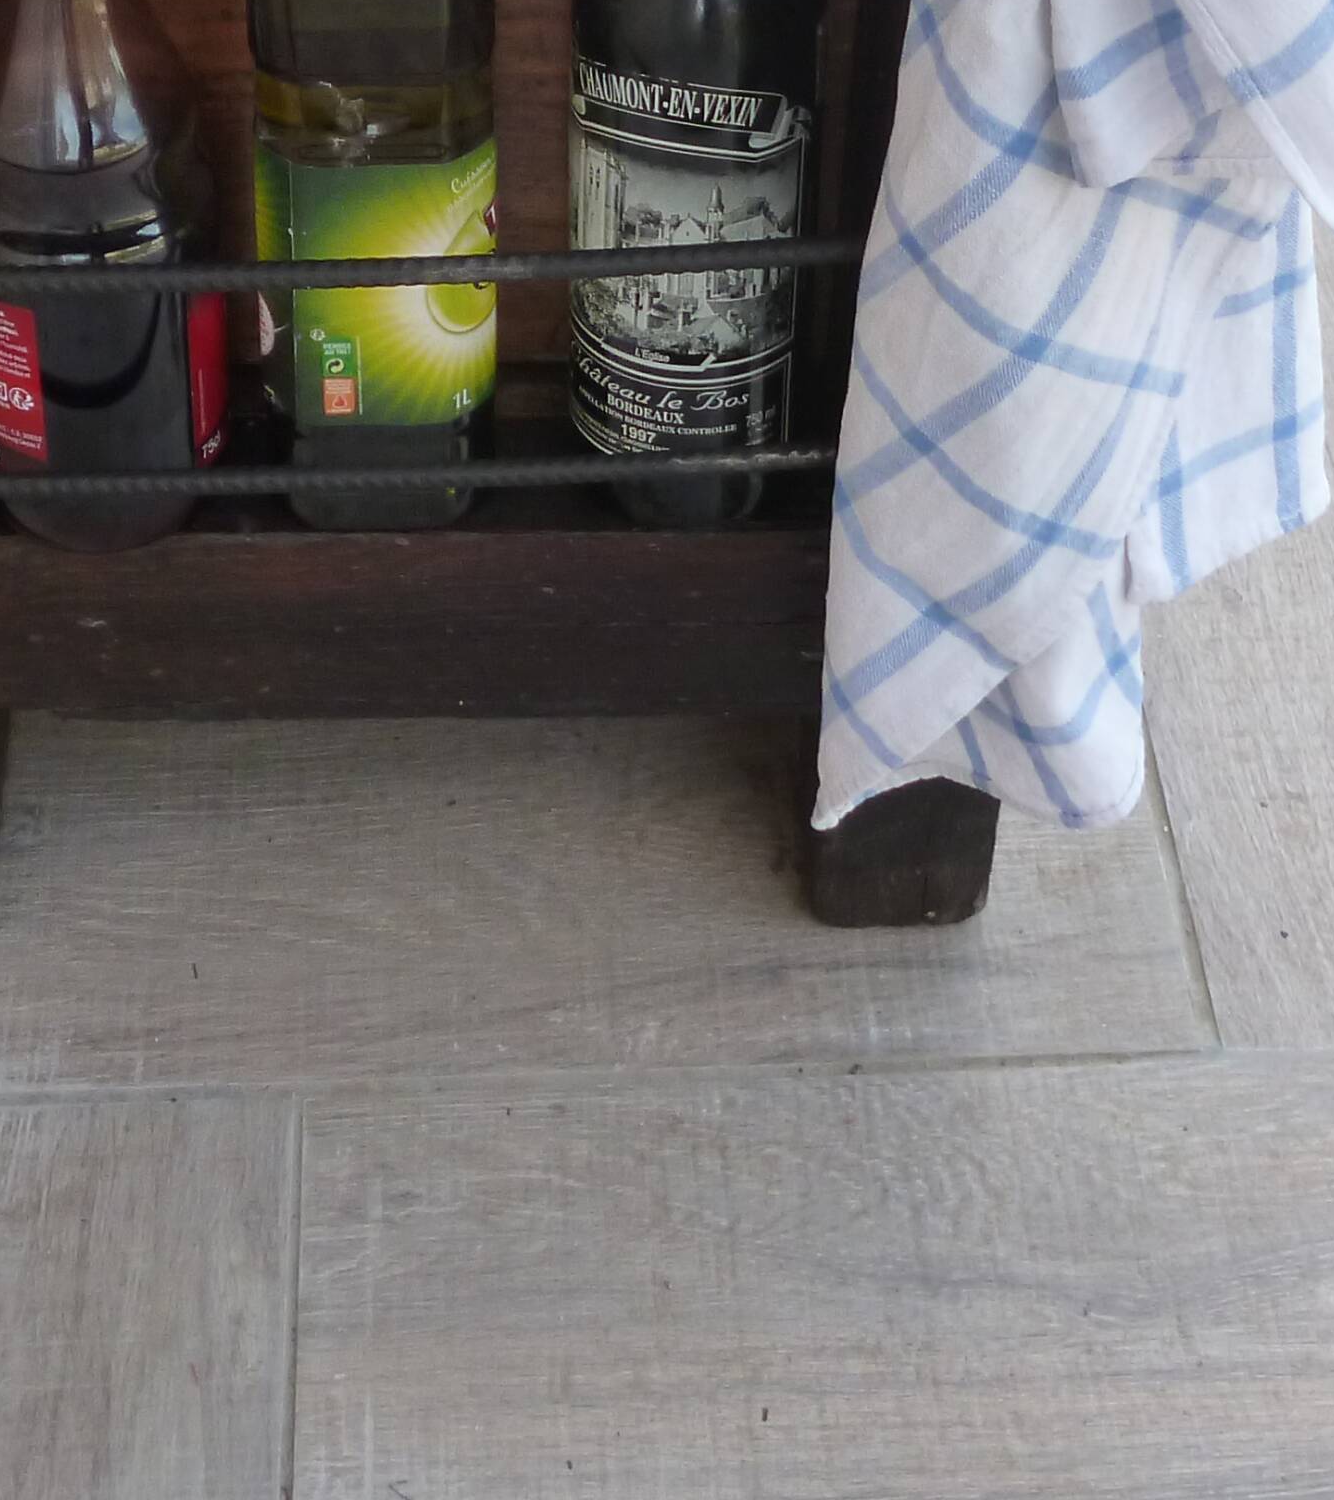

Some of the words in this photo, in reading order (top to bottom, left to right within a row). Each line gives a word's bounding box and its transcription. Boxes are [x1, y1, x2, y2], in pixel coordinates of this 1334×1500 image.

[574, 350, 652, 405] hâteau
[657, 391, 684, 410] le
[690, 389, 749, 411] Bos
[578, 386, 624, 420] ELLATION
[607, 393, 686, 425] BORDEAUX
[621, 423, 657, 444] 1997
